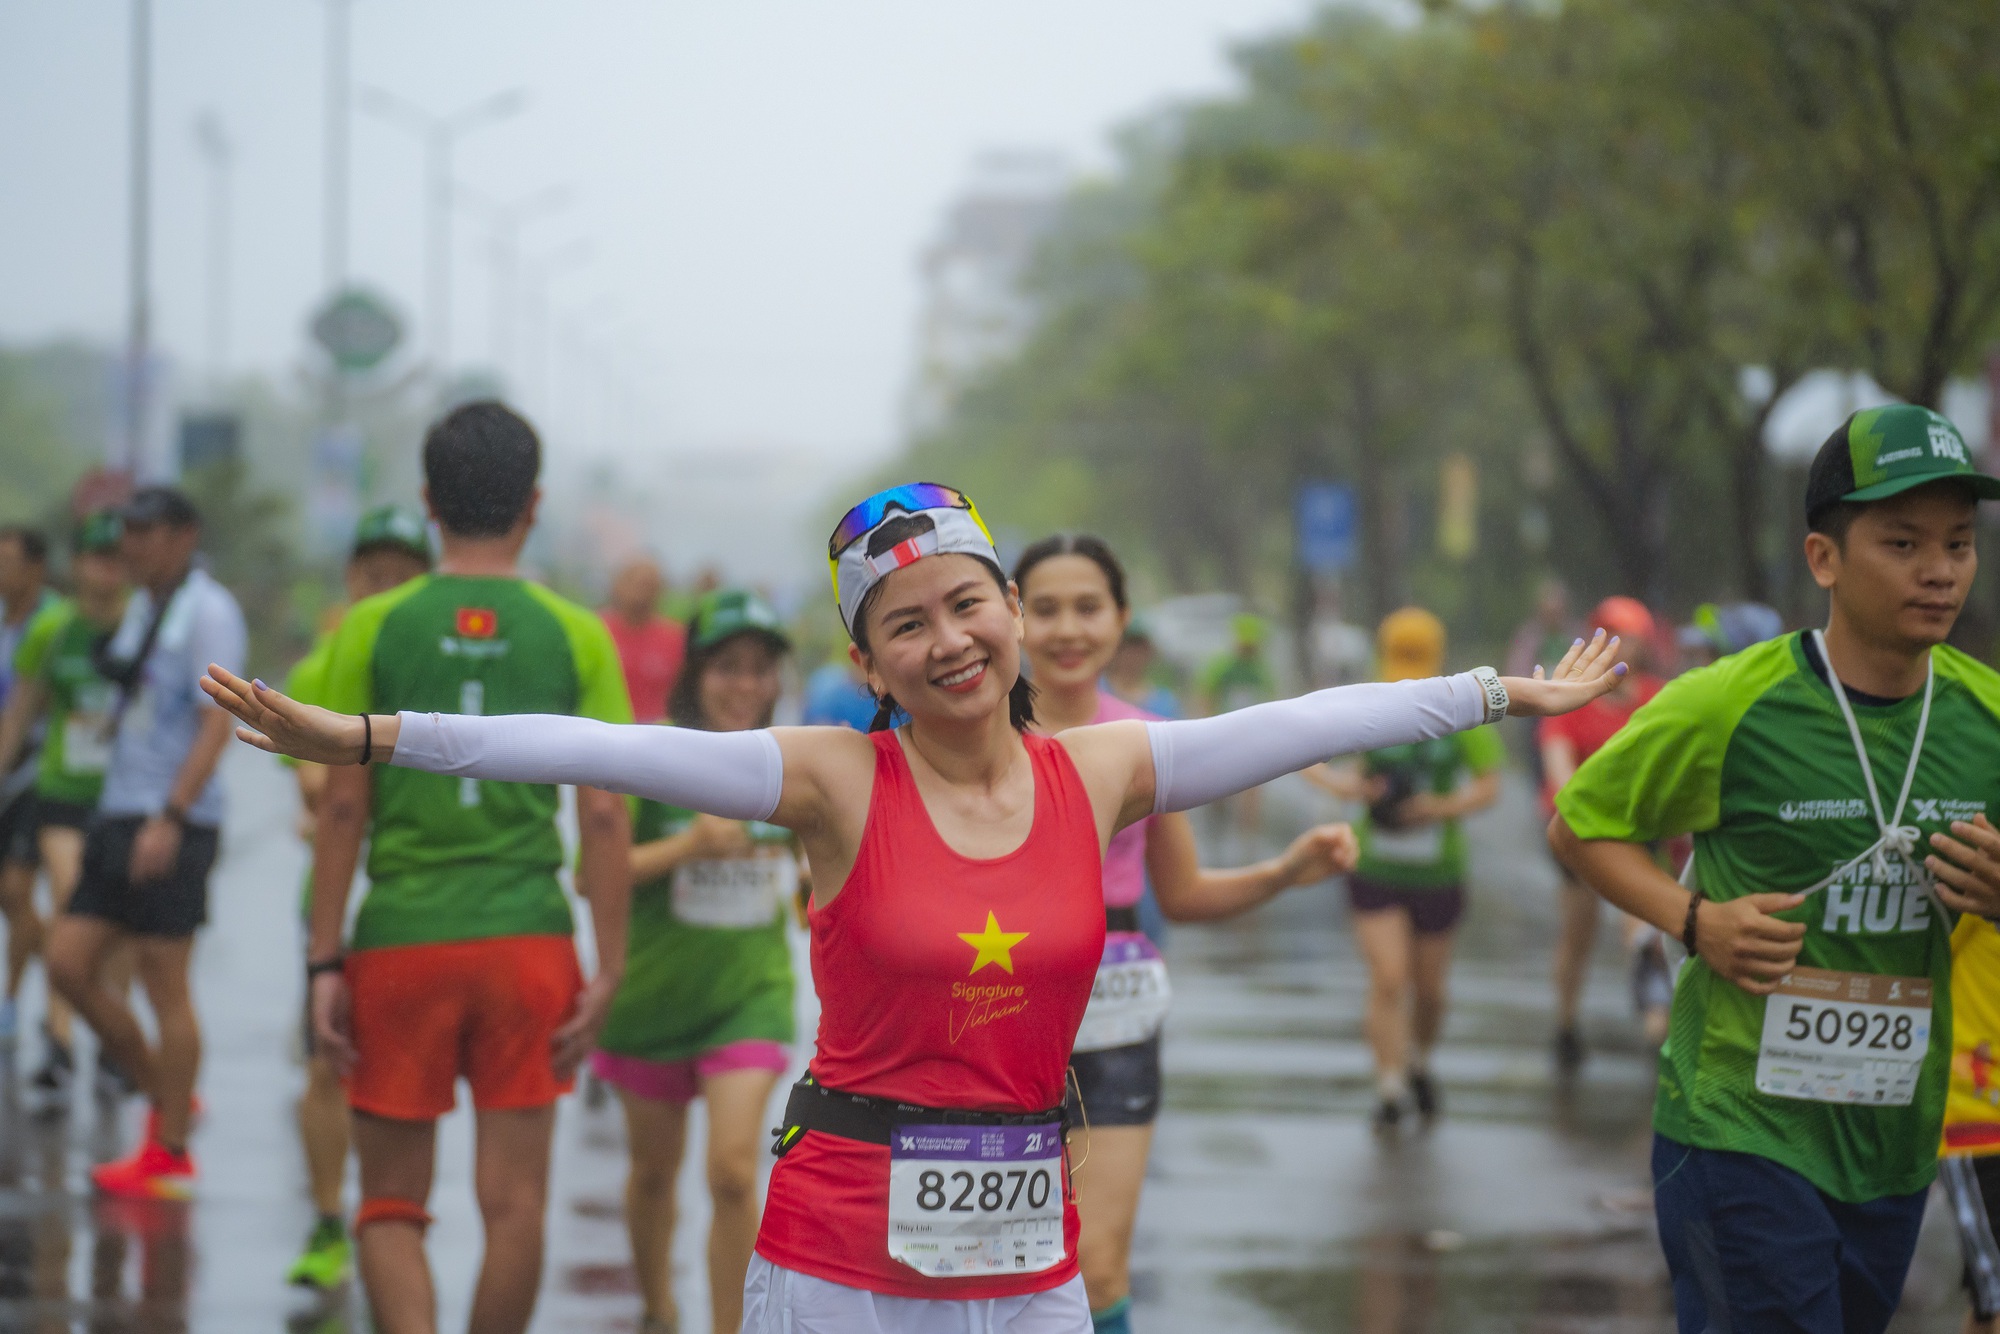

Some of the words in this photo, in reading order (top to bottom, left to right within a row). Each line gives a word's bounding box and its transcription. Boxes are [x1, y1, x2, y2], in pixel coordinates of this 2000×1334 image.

[1799, 808, 1868, 820] NUTRITION
[1822, 885, 1931, 933] HUE
[951, 981, 1024, 1001] Signature
[949, 996, 1029, 1045] Vietnam
[1785, 1004, 1912, 1050] 50928
[916, 1169, 1050, 1211] 82870
